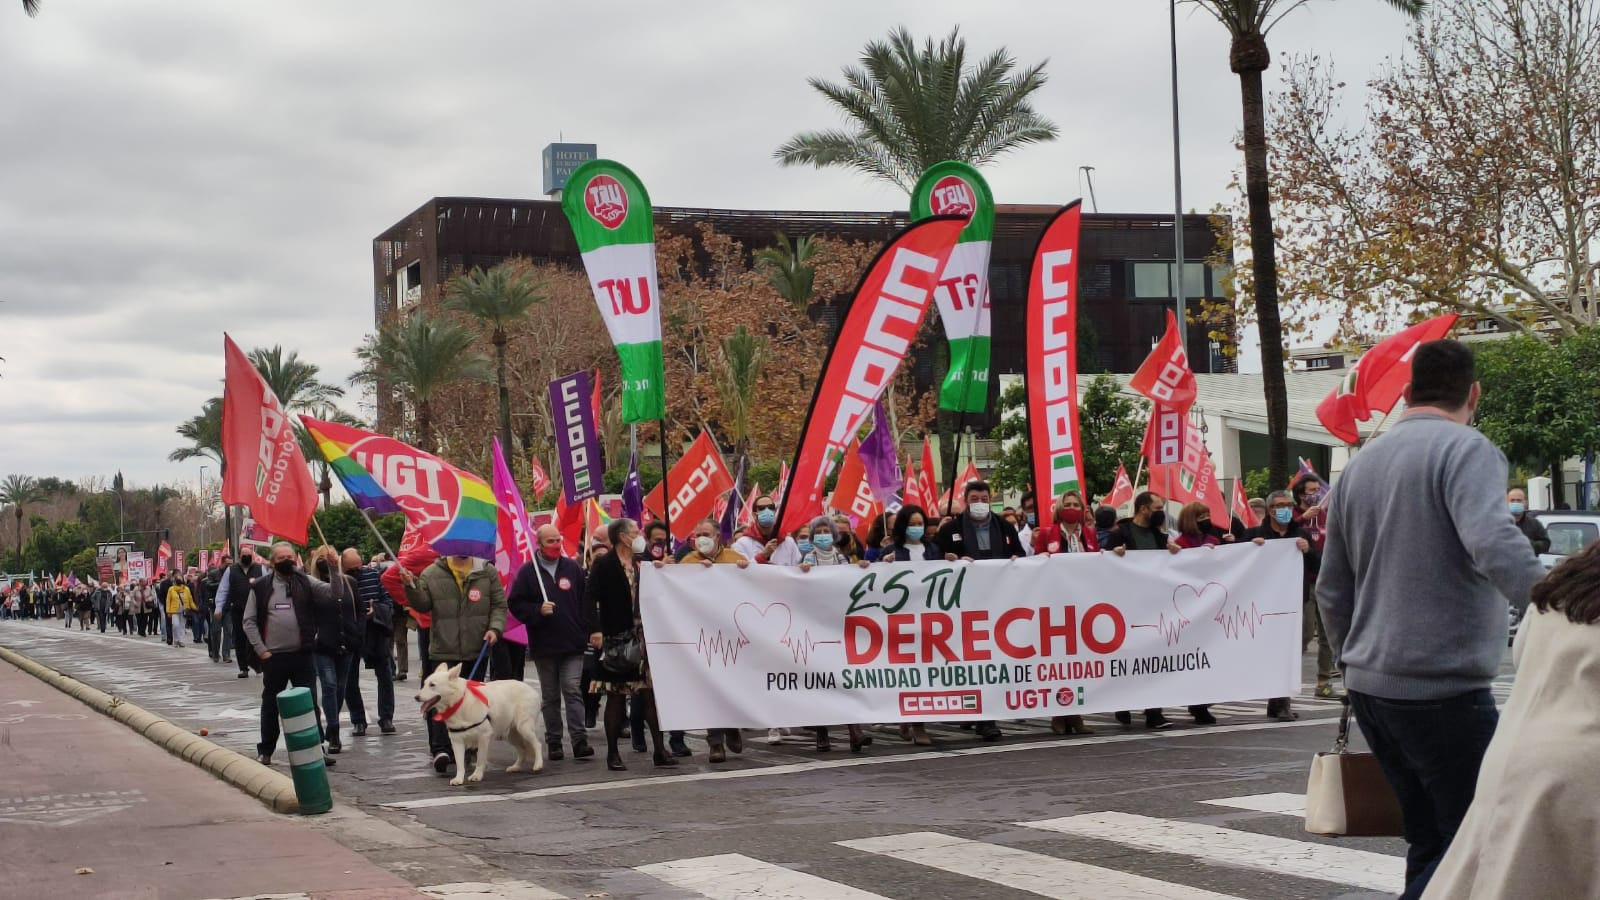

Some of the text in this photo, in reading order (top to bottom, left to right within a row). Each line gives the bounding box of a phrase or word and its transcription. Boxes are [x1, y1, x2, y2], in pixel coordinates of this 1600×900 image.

[556, 151, 590, 160] HOTEL
[556, 168, 573, 176] PAL
[1041, 248, 1072, 452] CCOO
[560, 379, 589, 471] CCOO
[356, 451, 443, 505] UGT
[846, 566, 966, 615] ES TU
[844, 602, 1126, 665] DERECHO
[767, 647, 1211, 690] POR UNA SANIDAD PÚBLICA DE CALIDAD EN ANDALUCÍA
[903, 695, 963, 712] CCOO
[1006, 688, 1051, 710] UGT
